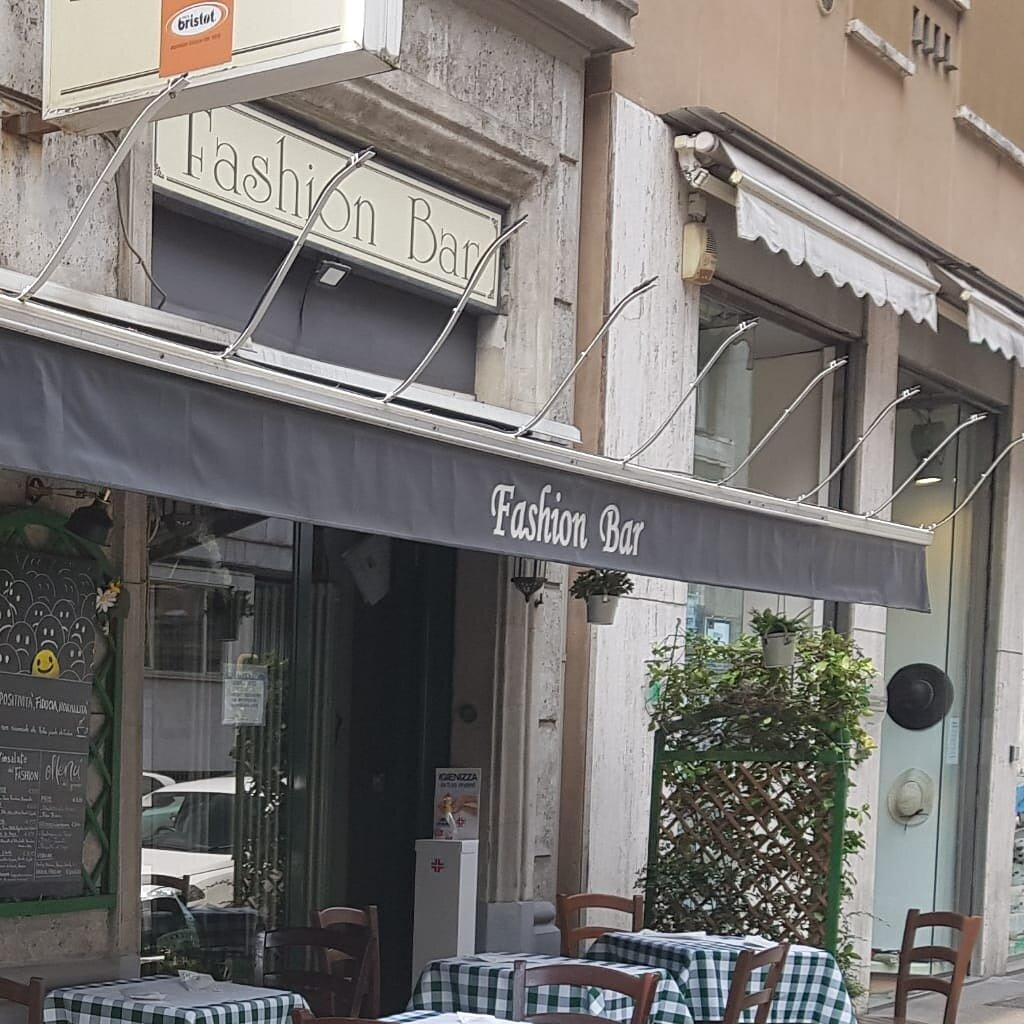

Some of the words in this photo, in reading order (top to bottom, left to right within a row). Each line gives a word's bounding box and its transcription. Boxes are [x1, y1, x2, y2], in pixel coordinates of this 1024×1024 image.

[177, 8, 216, 31] bristot
[183, 109, 376, 247] Fashion
[407, 195, 481, 281] Bar
[490, 483, 588, 549] Fashion
[599, 504, 645, 556] Bar
